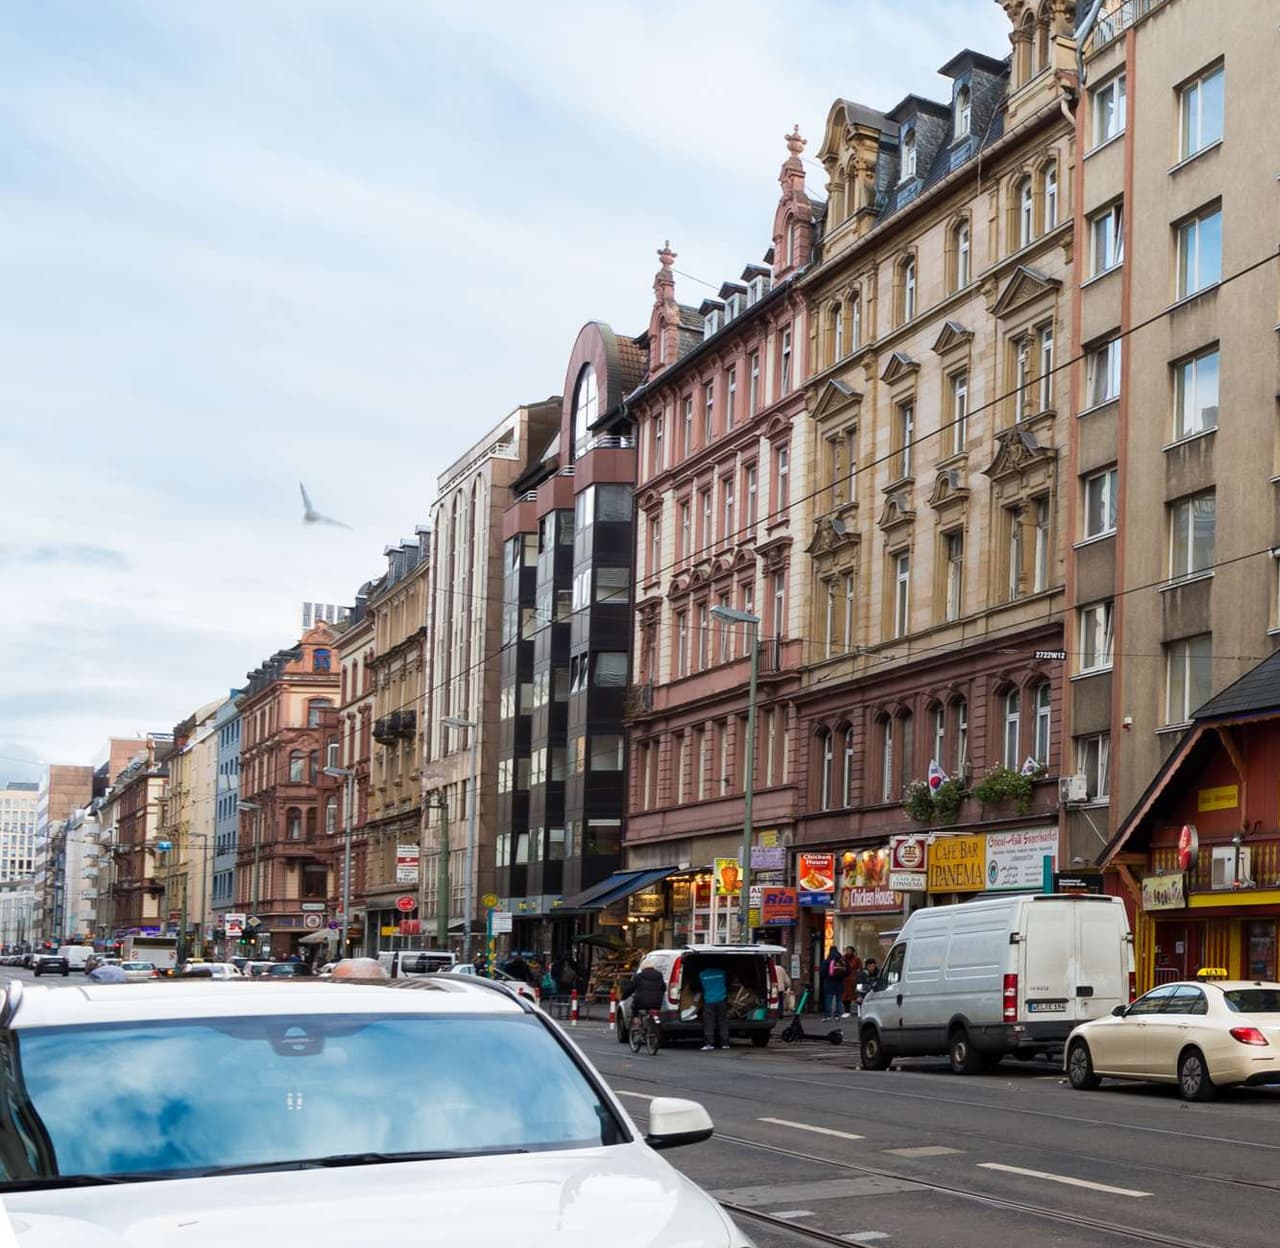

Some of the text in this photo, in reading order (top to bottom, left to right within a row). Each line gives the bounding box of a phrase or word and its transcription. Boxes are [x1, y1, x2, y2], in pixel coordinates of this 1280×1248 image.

[960, 840, 979, 859] BAR
[930, 863, 983, 888] IPANEMA
[765, 890, 795, 904] Ria
[850, 889, 875, 907] Chicken
[874, 887, 895, 905] House
